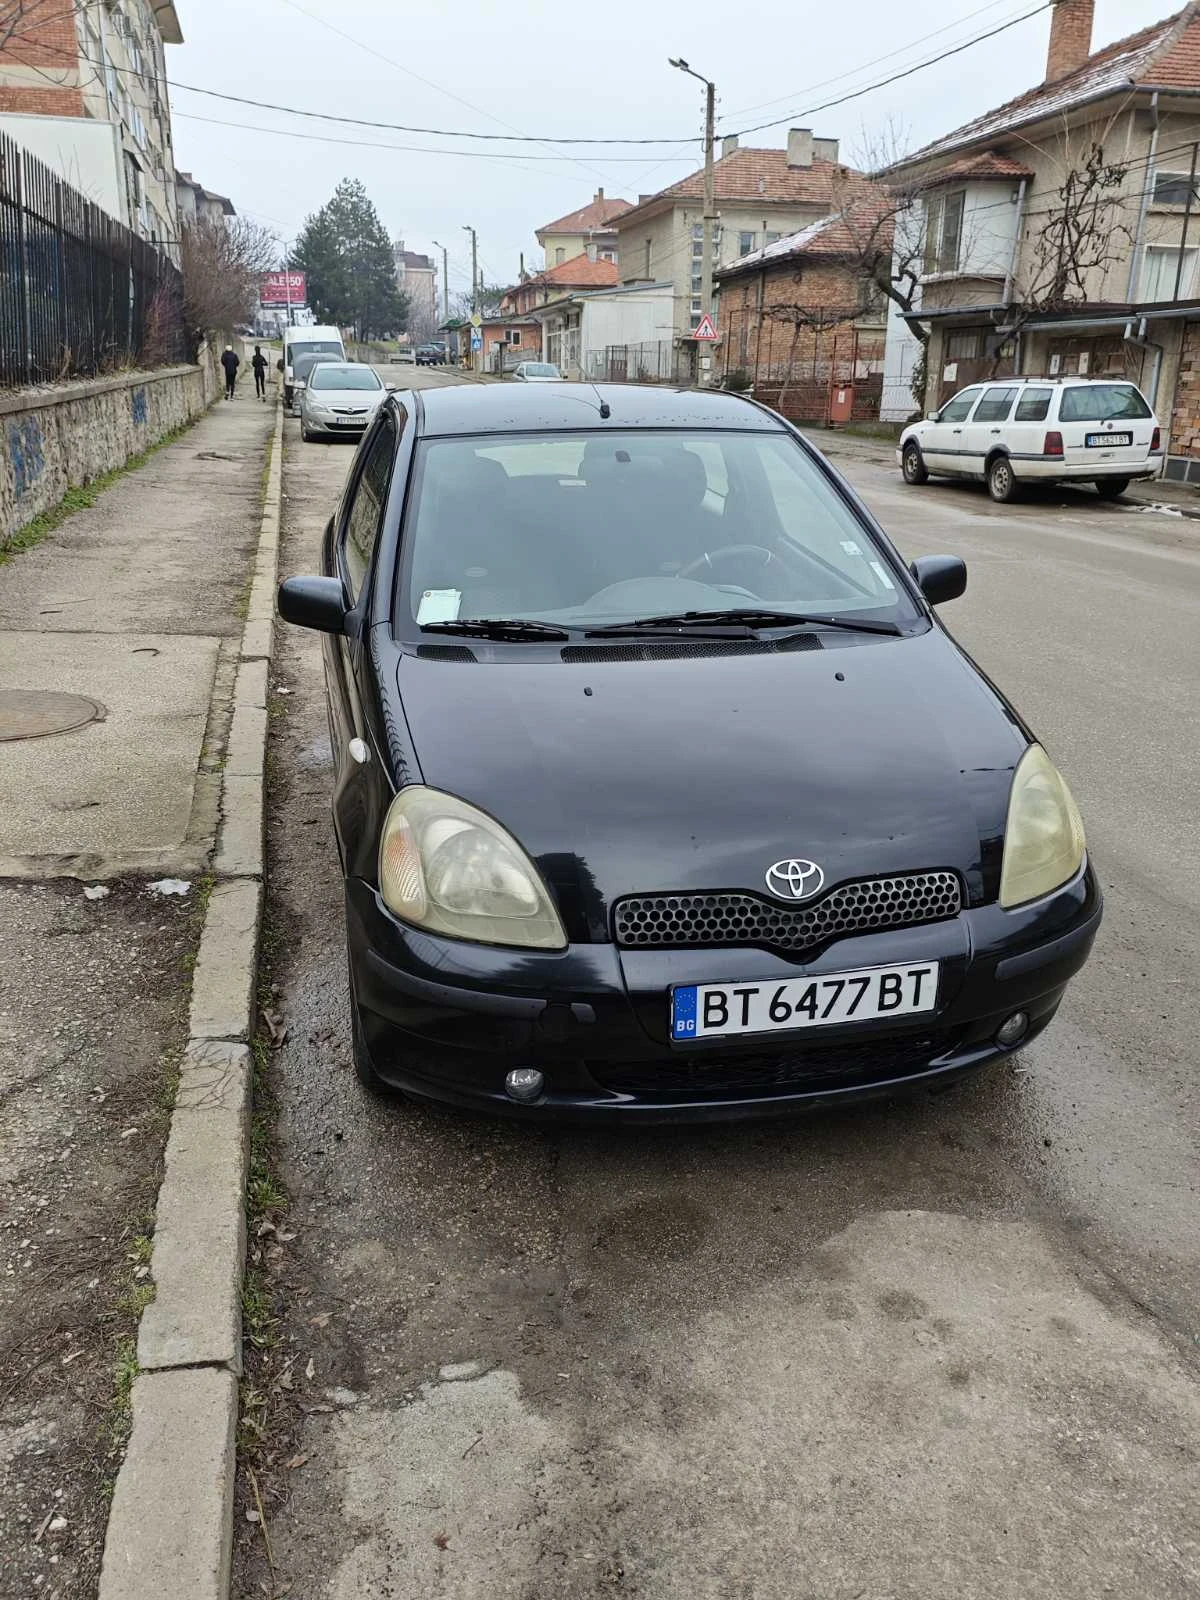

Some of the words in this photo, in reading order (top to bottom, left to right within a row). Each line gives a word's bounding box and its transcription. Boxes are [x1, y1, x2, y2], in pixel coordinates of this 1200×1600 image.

[703, 988, 759, 1028] BT
[769, 976, 871, 1023] 6477
[878, 969, 931, 1012] BT
[677, 1019, 695, 1031] BG
